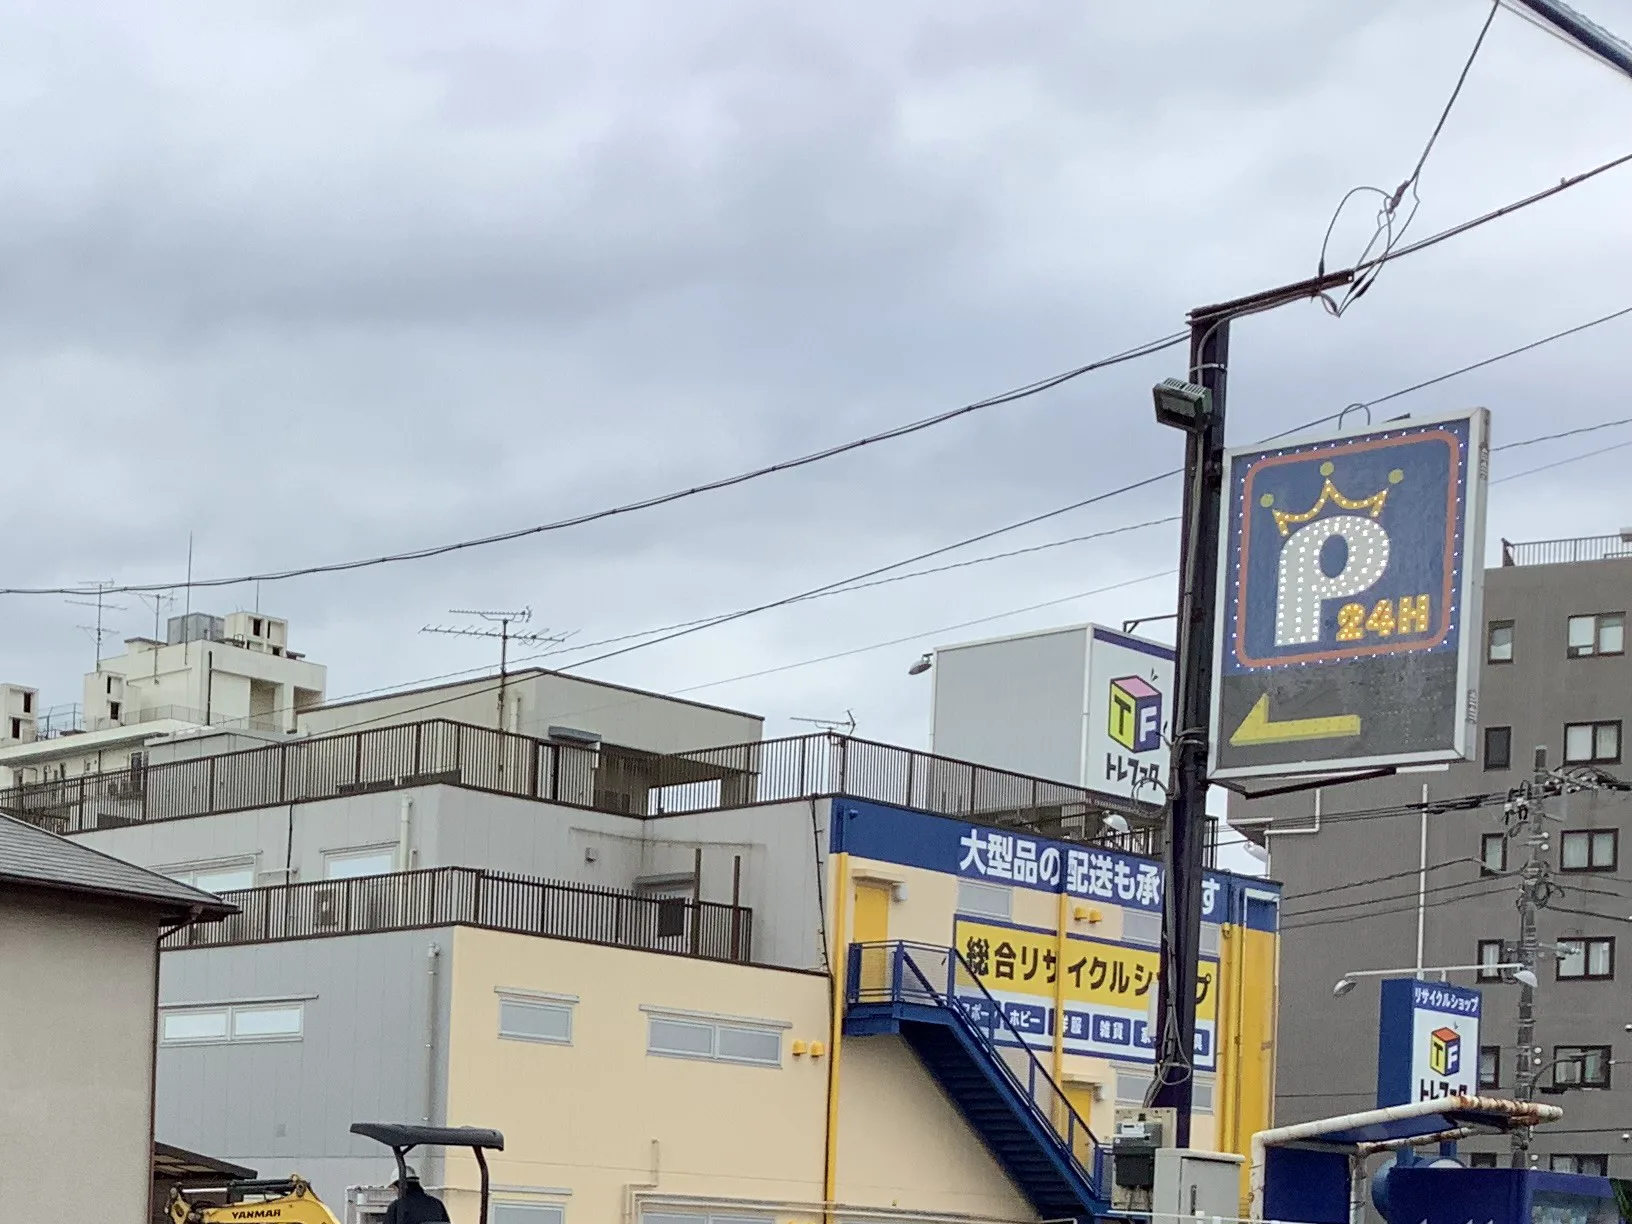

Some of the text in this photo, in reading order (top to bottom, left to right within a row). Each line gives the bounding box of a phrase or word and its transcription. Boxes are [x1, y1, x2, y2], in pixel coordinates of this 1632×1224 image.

[1336, 594, 1430, 642] 24H
[1414, 987, 1479, 1012] リサイクルショップ
[232, 1209, 281, 1220] YANMAR
